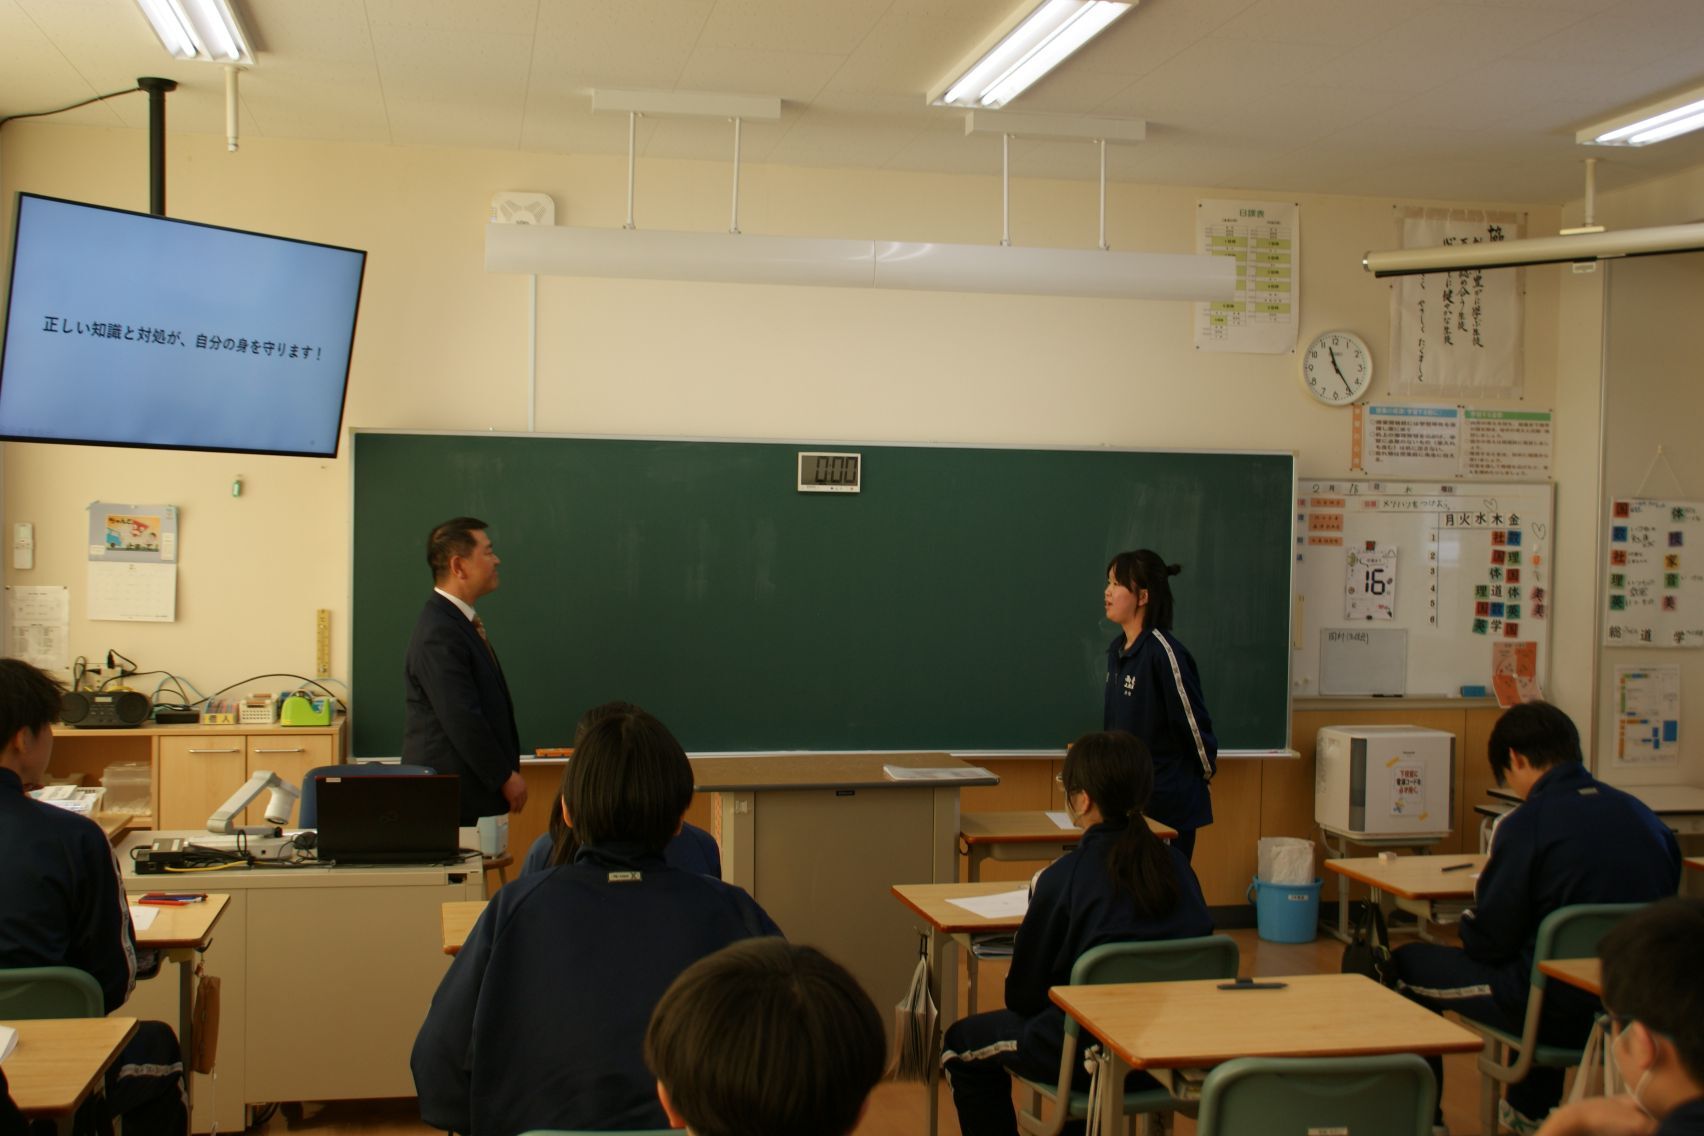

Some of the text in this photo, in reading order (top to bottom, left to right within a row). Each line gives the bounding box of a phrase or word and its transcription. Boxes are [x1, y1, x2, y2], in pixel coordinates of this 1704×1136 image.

[1321, 341, 1326, 349] 11
[1332, 338, 1339, 346] 12
[1354, 350, 1360, 358] 2
[1308, 364, 1314, 372] 9
[1358, 364, 1363, 372] 3
[1311, 377, 1317, 385] 8
[1354, 377, 1360, 385] 4
[1321, 387, 1326, 395] 7
[1333, 391, 1339, 400] 6
[815, 456, 858, 483] 0:00
[1446, 512, 1520, 526] 月 火 水 木 金
[1430, 552, 1435, 560] 2
[1508, 551, 1519, 563] 理
[1490, 567, 1502, 580] 体
[1365, 568, 1386, 595] 16
[1476, 585, 1487, 598] 理
[1430, 599, 1435, 607] 5
[1491, 619, 1502, 632] 学
